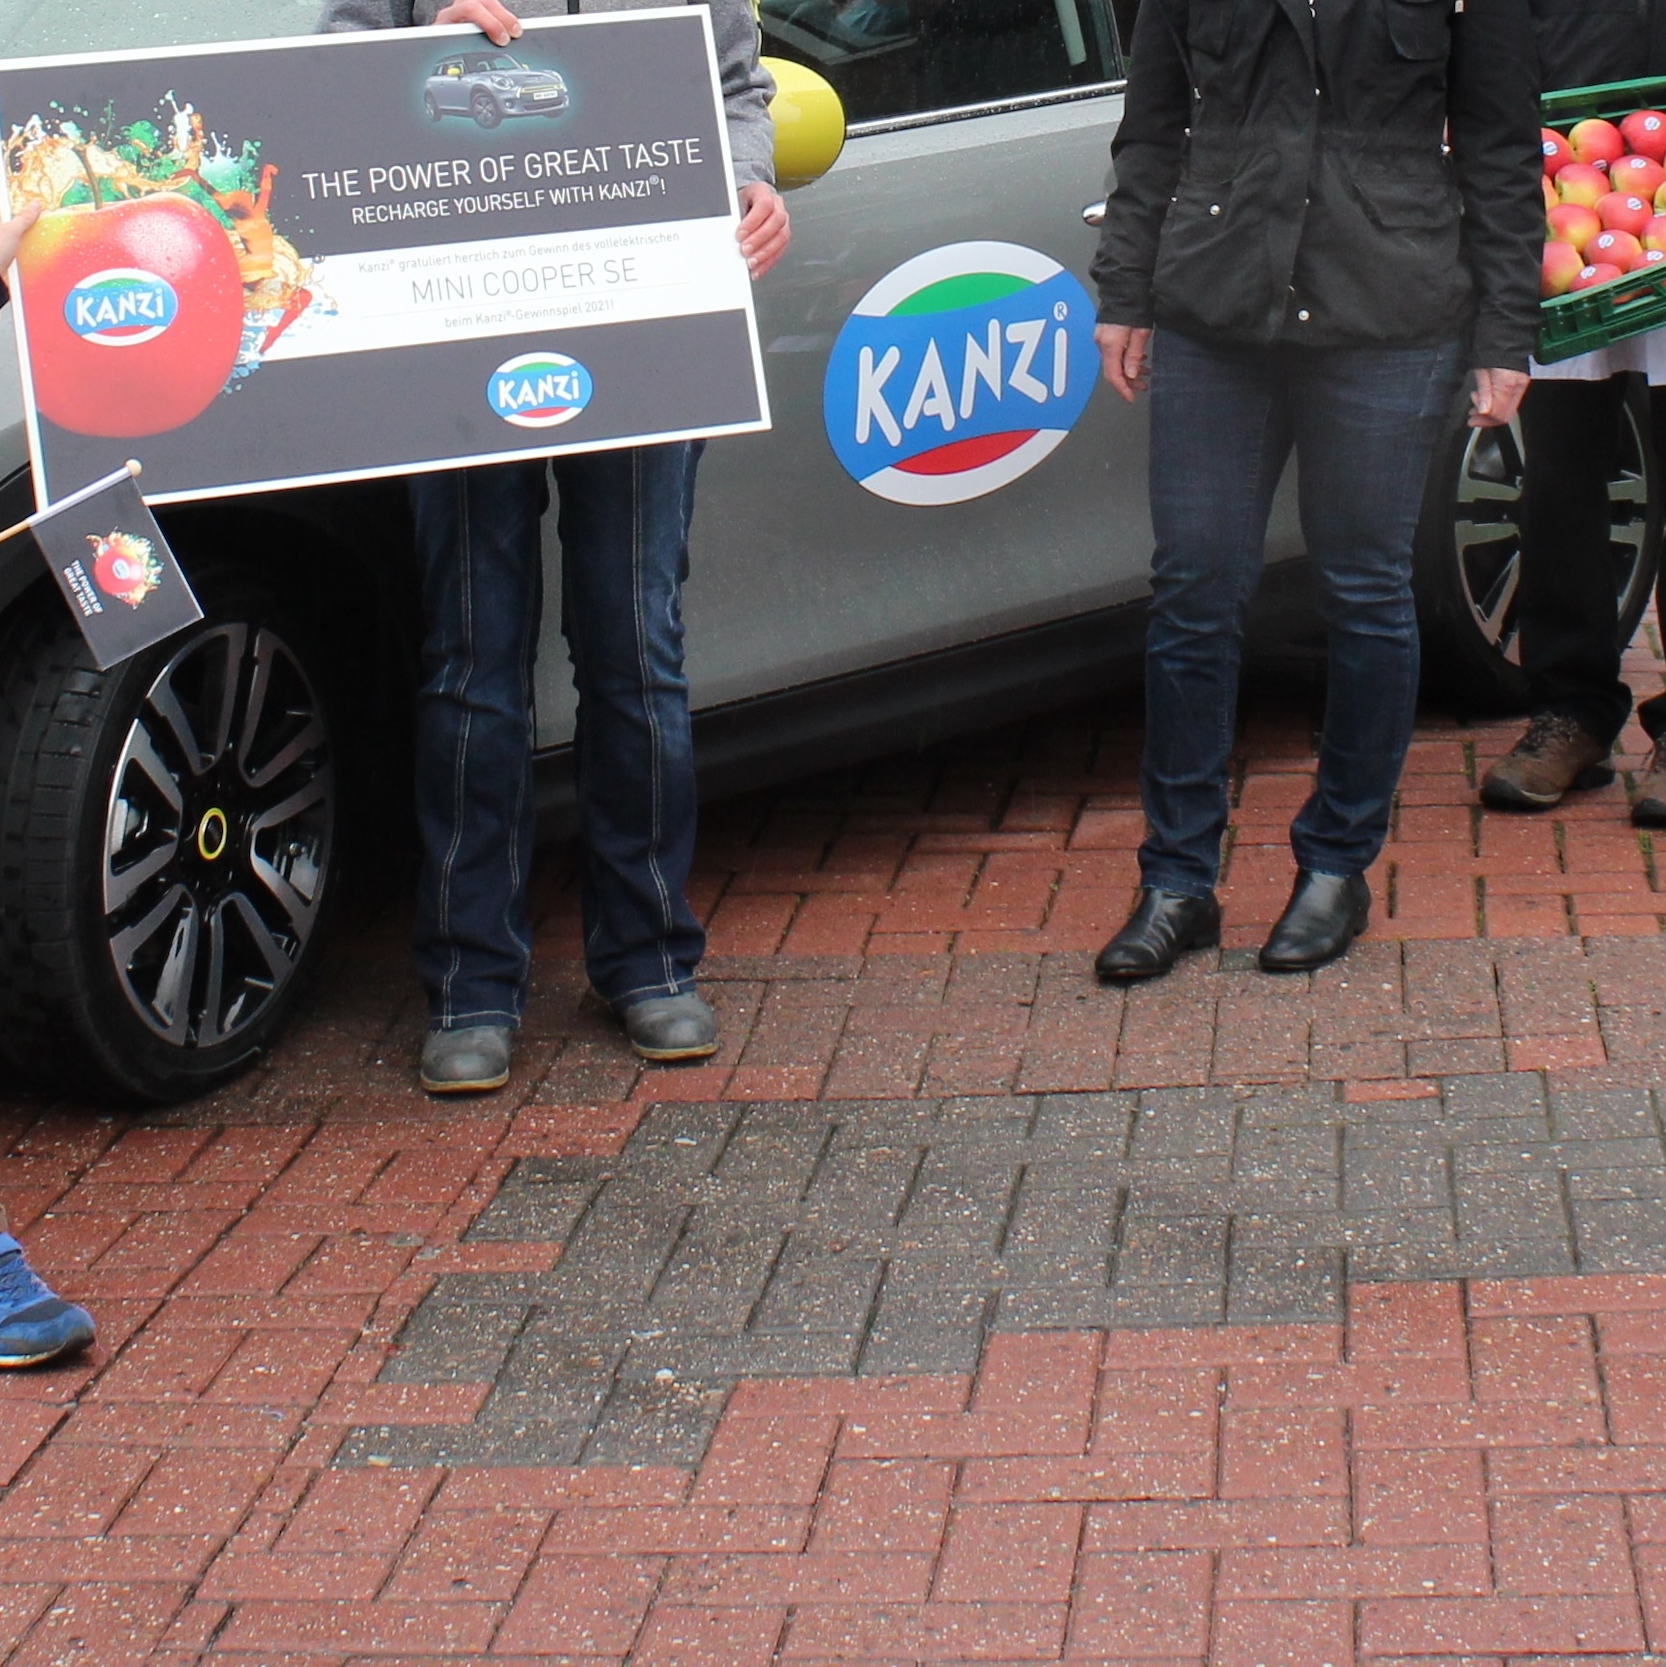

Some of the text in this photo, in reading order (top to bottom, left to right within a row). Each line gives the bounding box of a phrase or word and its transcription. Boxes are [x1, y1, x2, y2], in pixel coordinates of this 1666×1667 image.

[302, 138, 703, 200] THE POWER OF GREAT TASTE
[352, 199, 450, 225] RECHARGE
[453, 189, 545, 215] YOURSELF
[549, 185, 594, 206] WITH
[399, 254, 452, 271] gratuliert
[455, 248, 500, 264] herzlich
[502, 248, 526, 260] zum
[529, 244, 569, 257] Gewinn
[572, 240, 591, 252] des
[594, 232, 680, 249] vollelektrischen
[412, 256, 638, 304] MINI COOPER SE
[444, 315, 473, 328] beim
[585, 299, 615, 313] 2021!
[63, 567, 93, 617] GREAT TASTE
[71, 559, 104, 614] THE POWER OF
